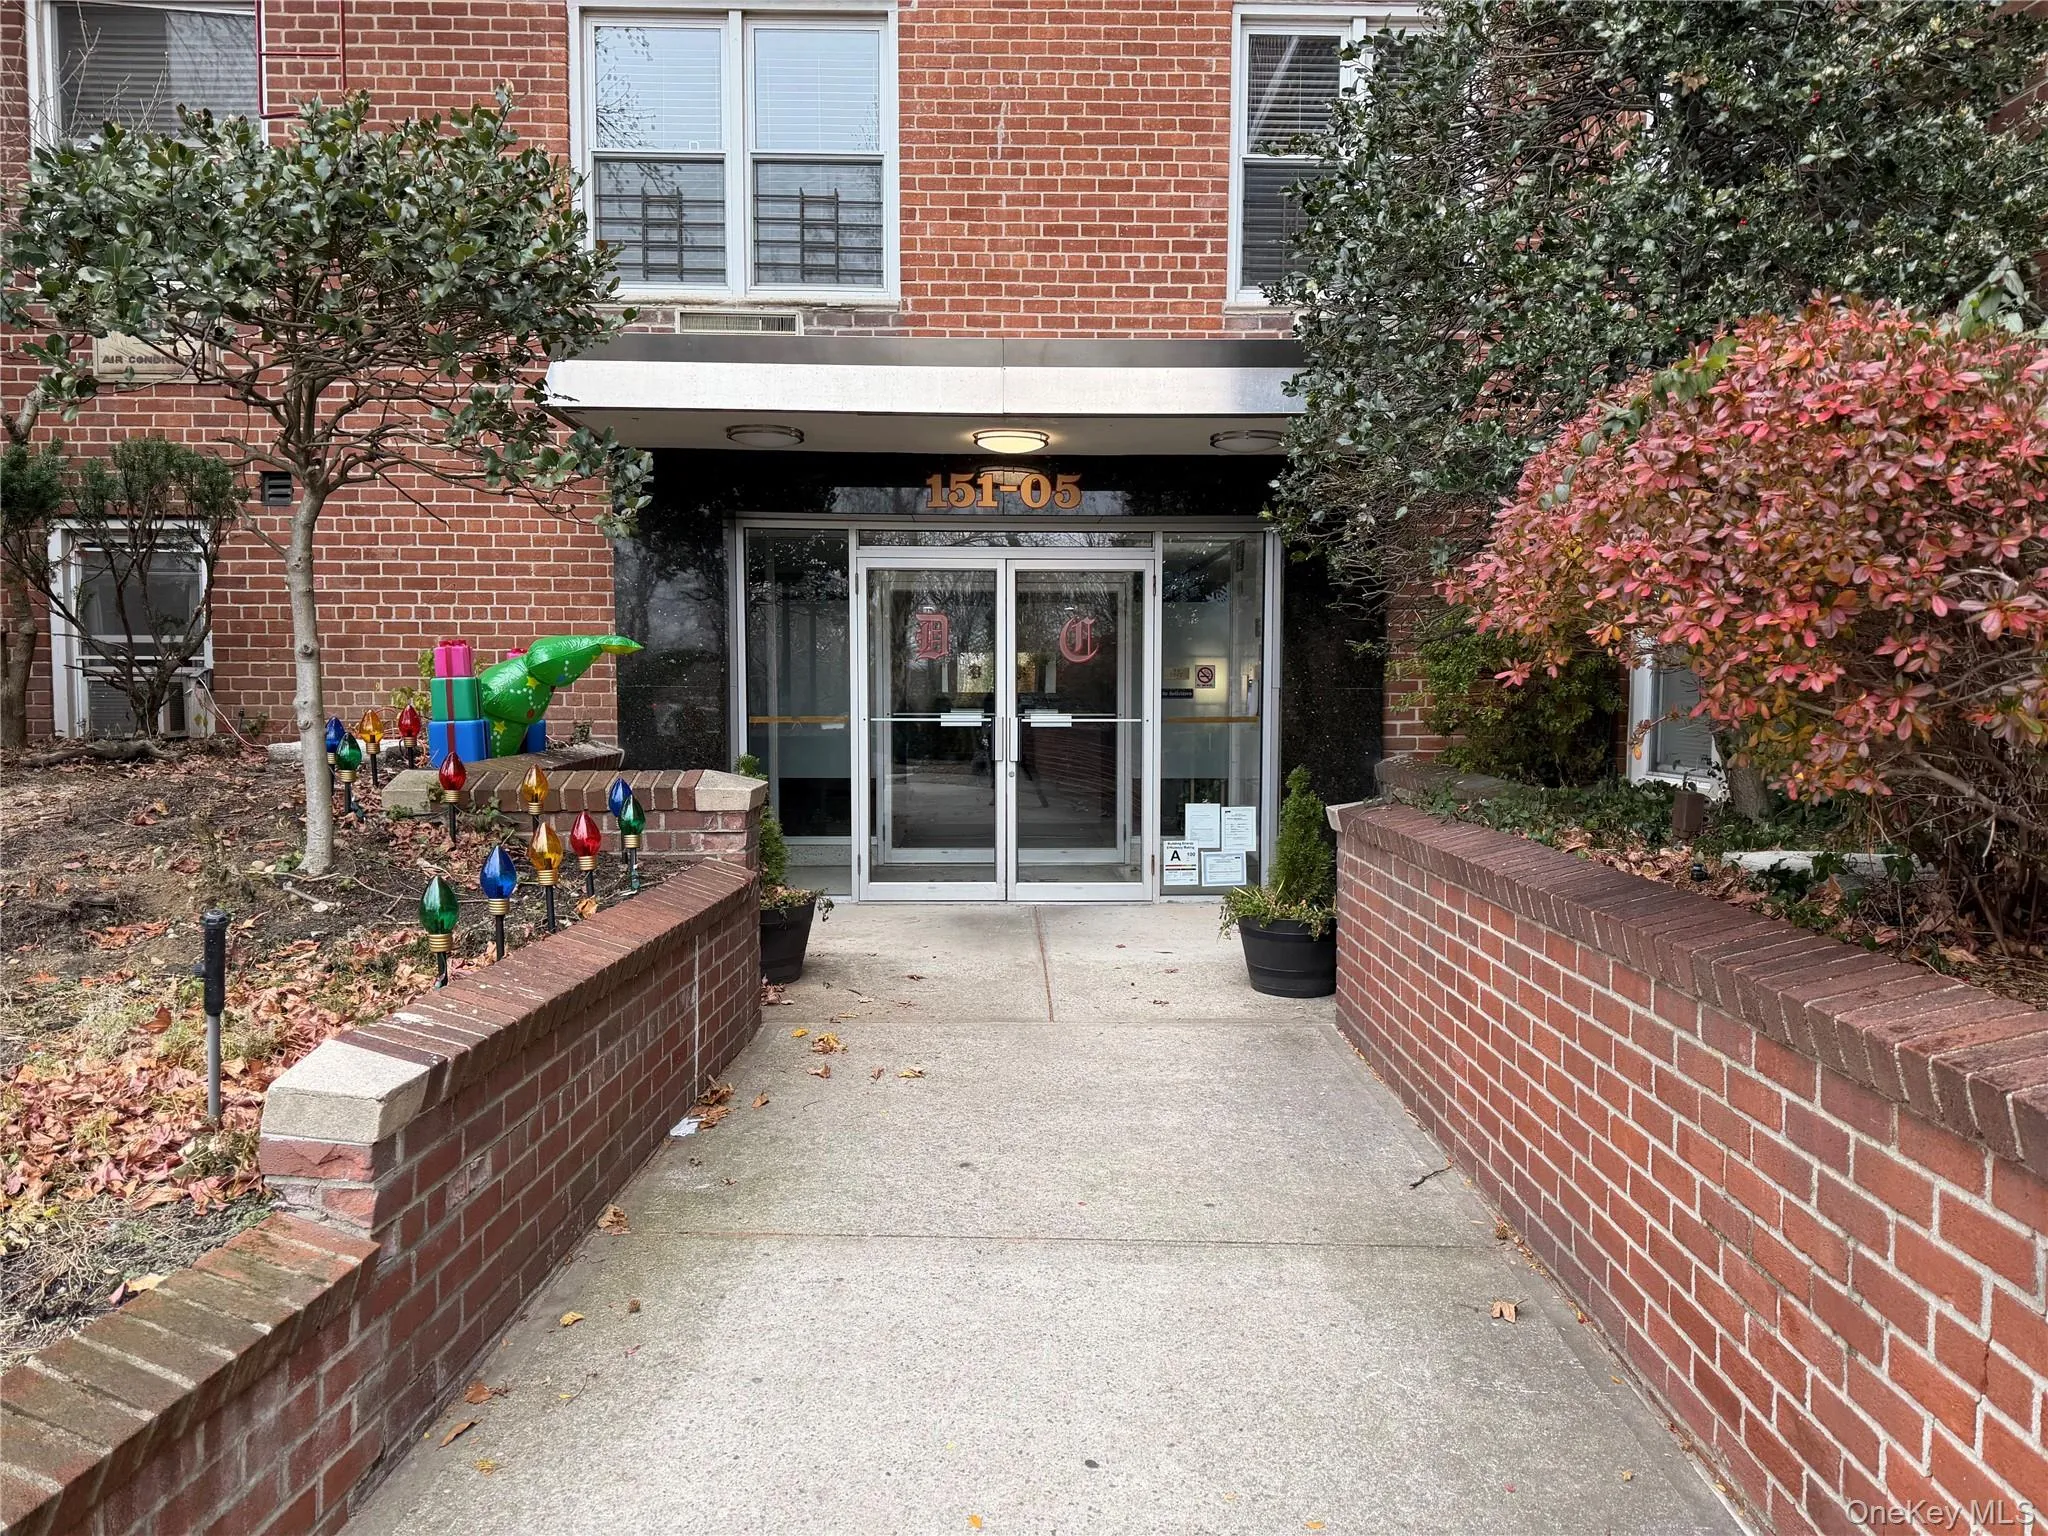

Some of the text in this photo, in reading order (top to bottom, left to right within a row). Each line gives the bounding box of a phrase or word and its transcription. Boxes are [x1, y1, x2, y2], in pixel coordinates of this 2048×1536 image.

[102, 355, 123, 364] AIR
[925, 473, 1082, 509] 151-05
[1170, 850, 1181, 861] A
